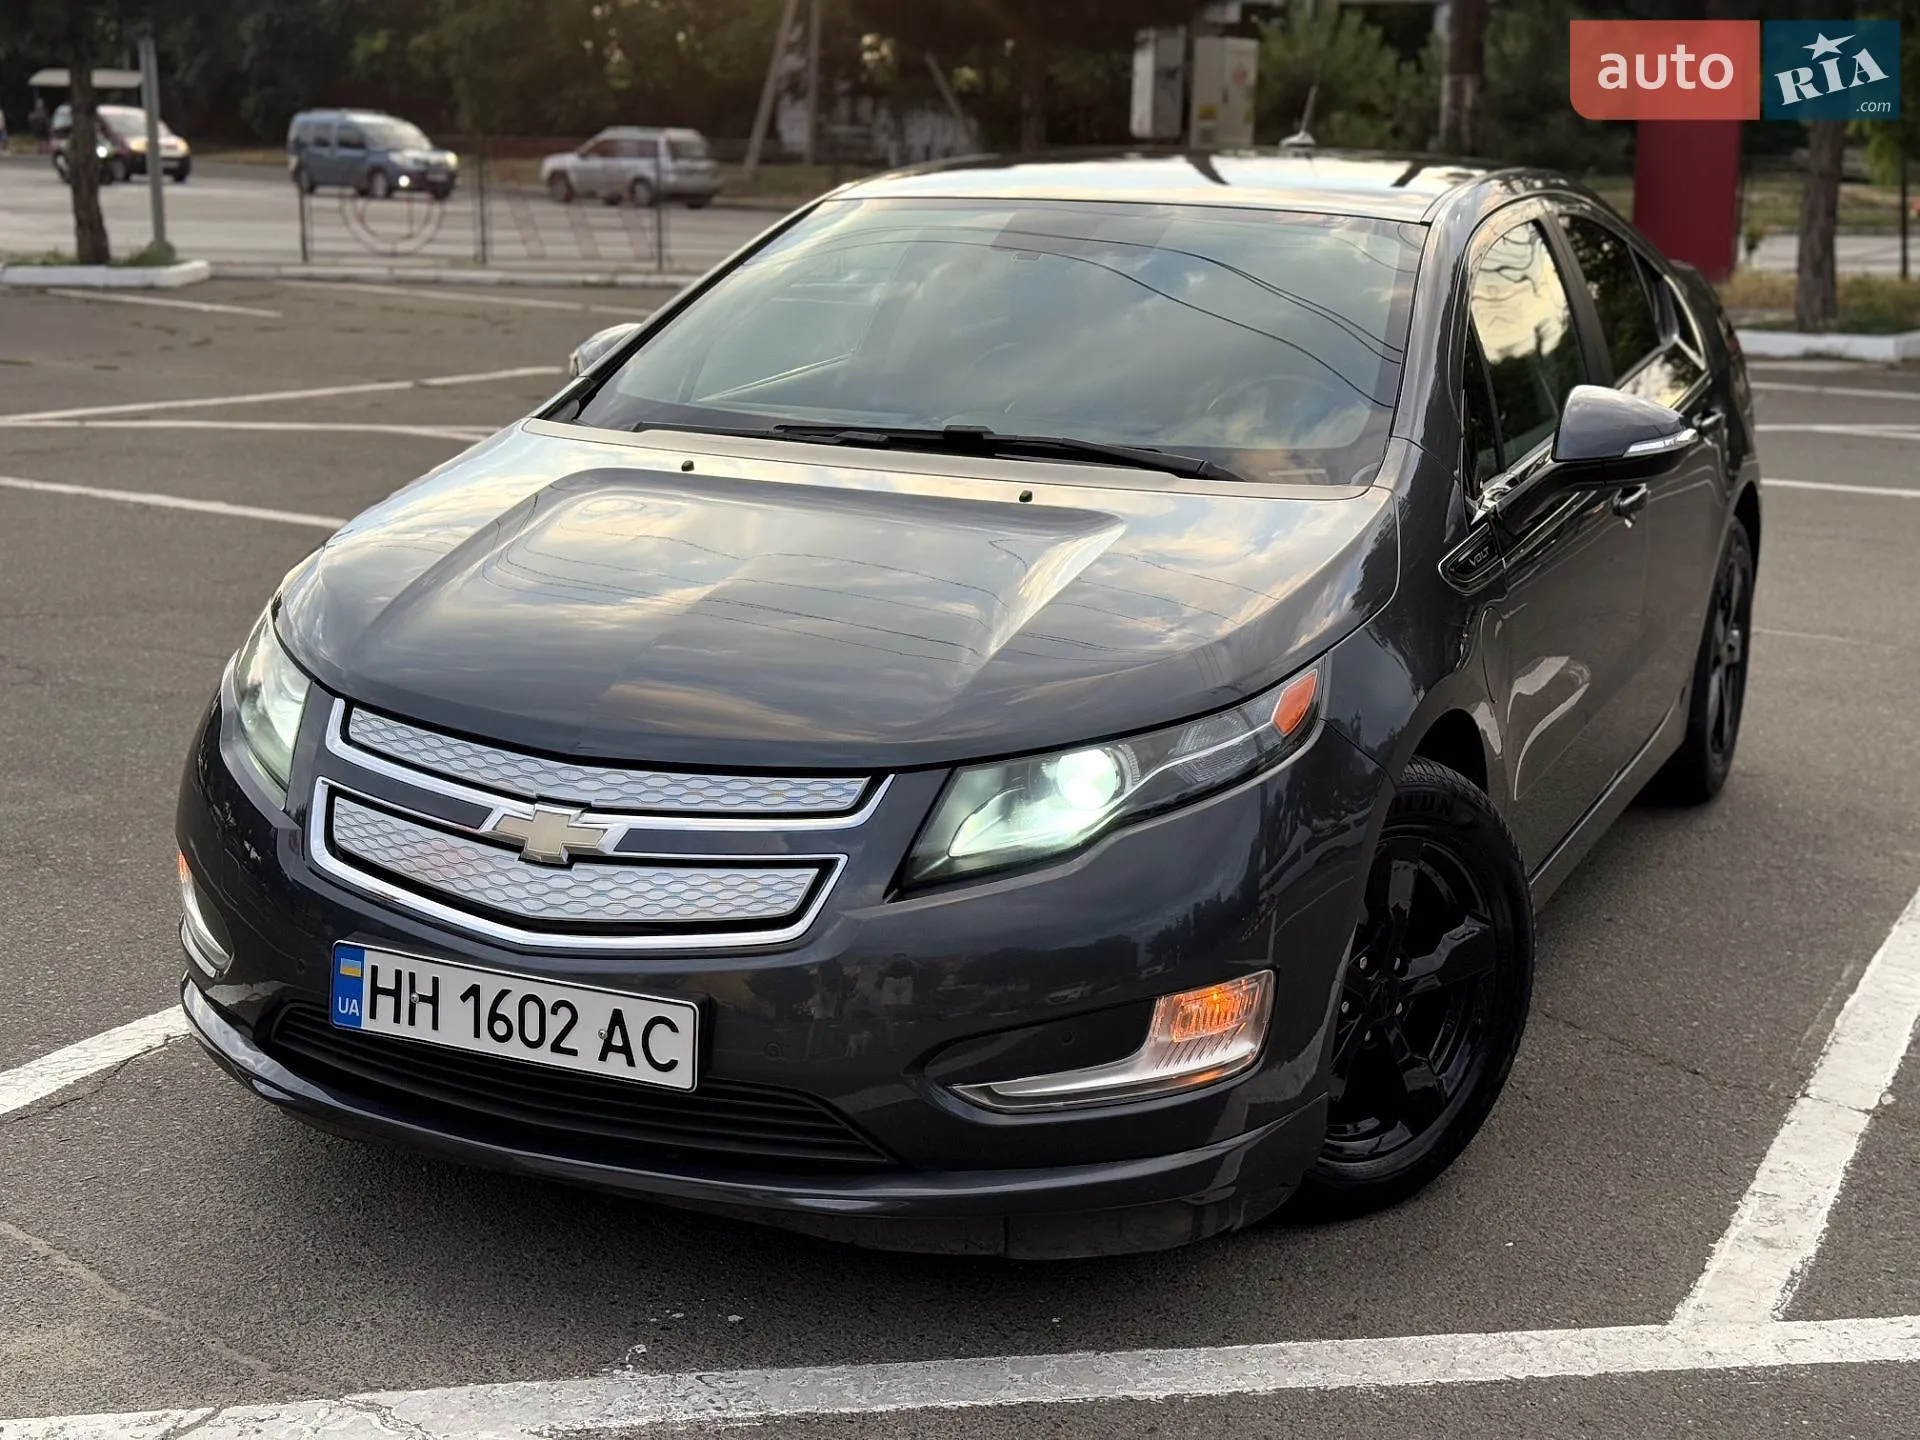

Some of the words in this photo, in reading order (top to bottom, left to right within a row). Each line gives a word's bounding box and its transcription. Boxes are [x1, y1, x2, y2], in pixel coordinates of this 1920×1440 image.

[1468, 546, 1490, 567] VOLT
[338, 996, 360, 1017] UA
[369, 965, 440, 1031] HH
[459, 984, 579, 1057] 1602
[598, 1008, 680, 1073] AC
